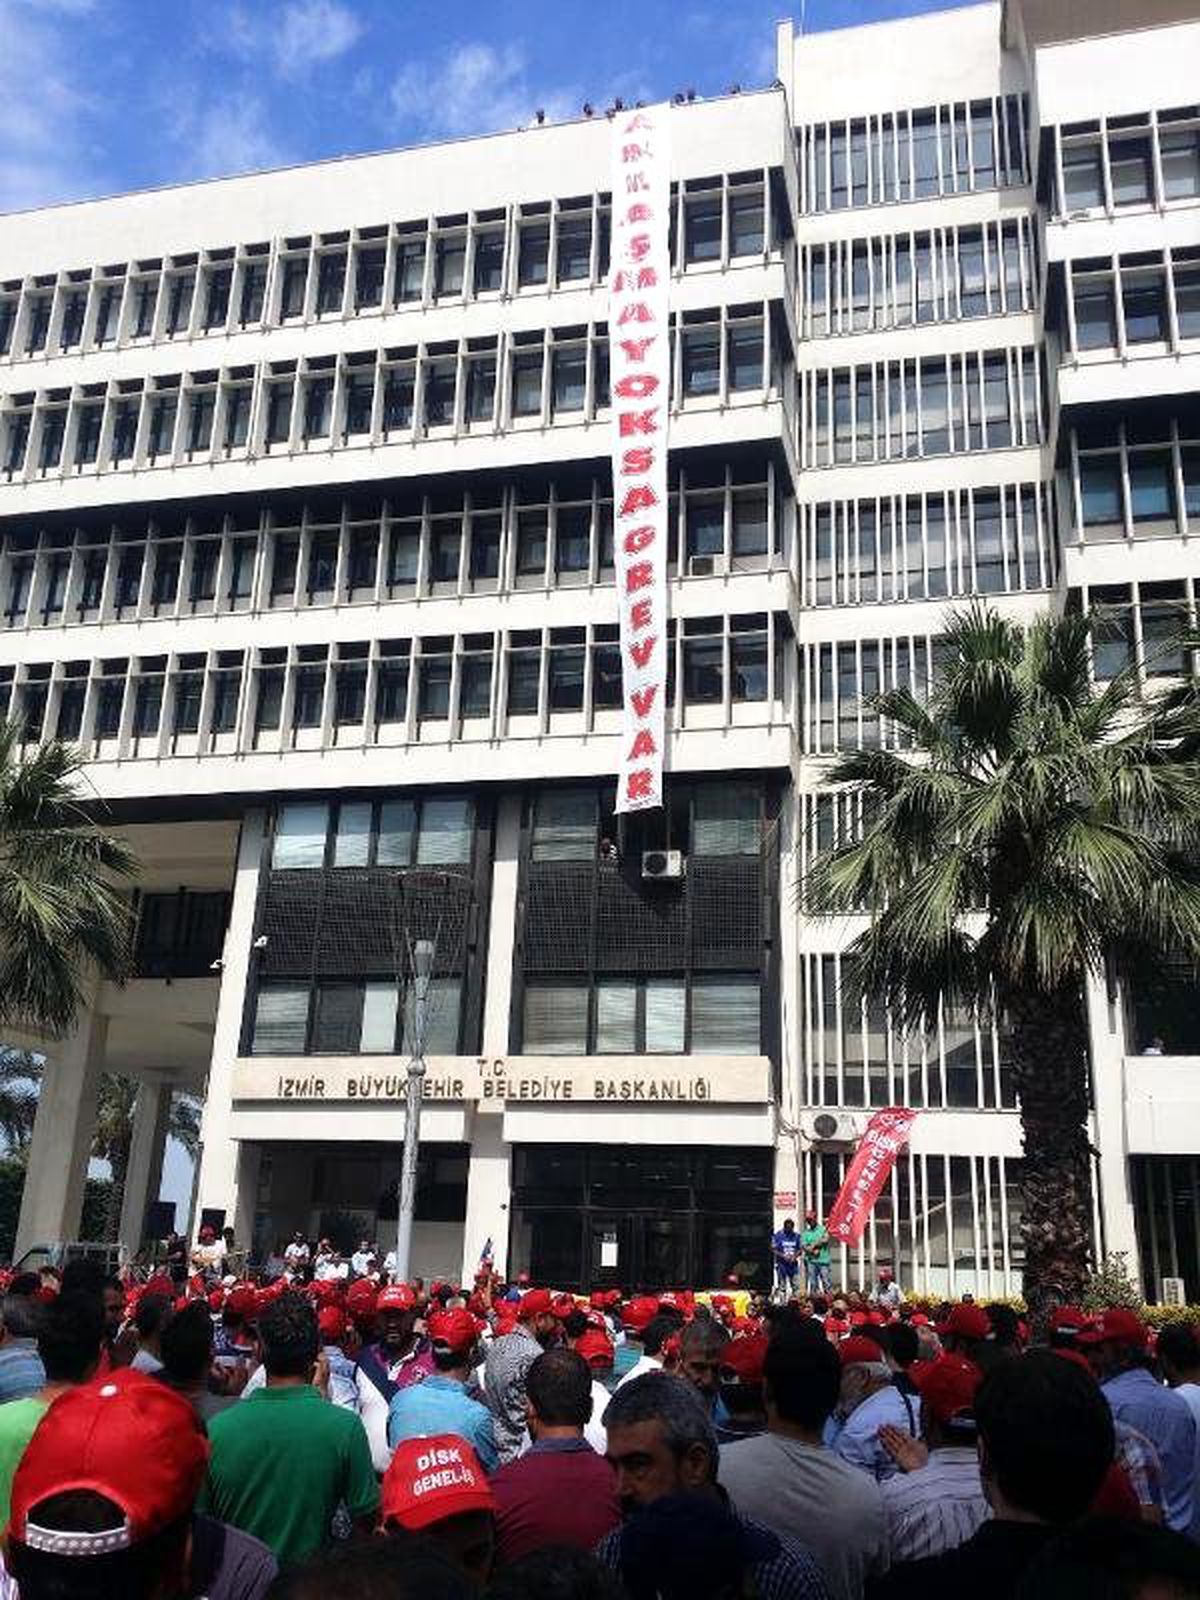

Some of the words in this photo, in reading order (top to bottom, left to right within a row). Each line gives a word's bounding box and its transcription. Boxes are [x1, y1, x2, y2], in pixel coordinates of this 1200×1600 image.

[627, 683, 659, 799] VAR
[477, 1059, 507, 1076] T.C.
[278, 1075, 325, 1097] İZMİR
[347, 1075, 464, 1098] BÜYÜKEHİR
[483, 1076, 573, 1099] BELEDİYE
[594, 1077, 712, 1100] BAŞKANLIĞI
[416, 1448, 463, 1472] DİSK
